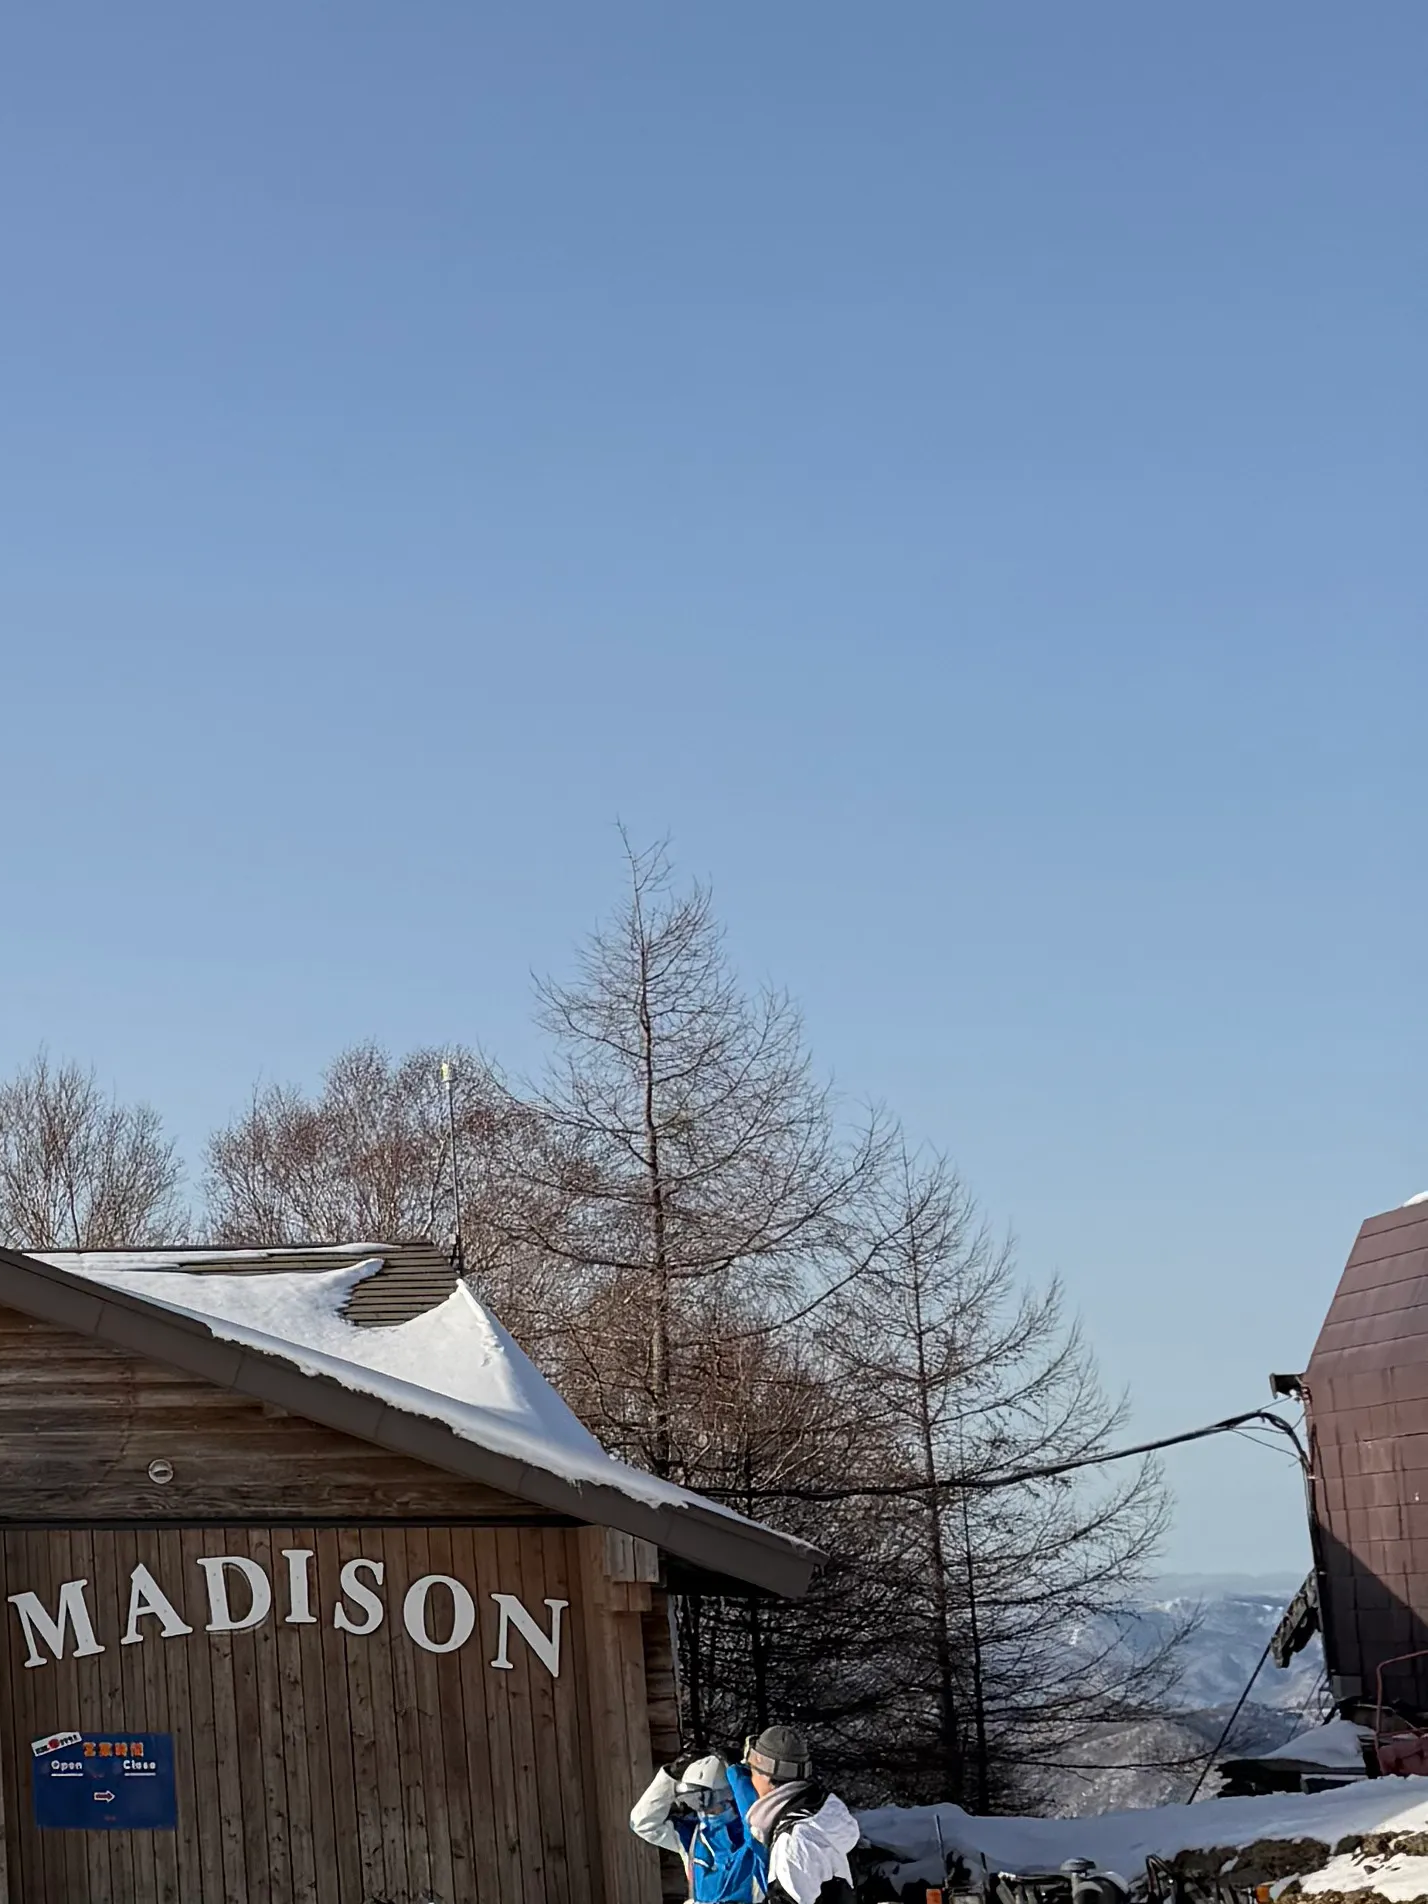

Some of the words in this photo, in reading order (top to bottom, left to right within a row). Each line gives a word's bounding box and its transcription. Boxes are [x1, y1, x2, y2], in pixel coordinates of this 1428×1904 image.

[7, 1549, 569, 1678] MADISON
[51, 1760, 83, 1772] Open
[123, 1759, 157, 1770] Close
